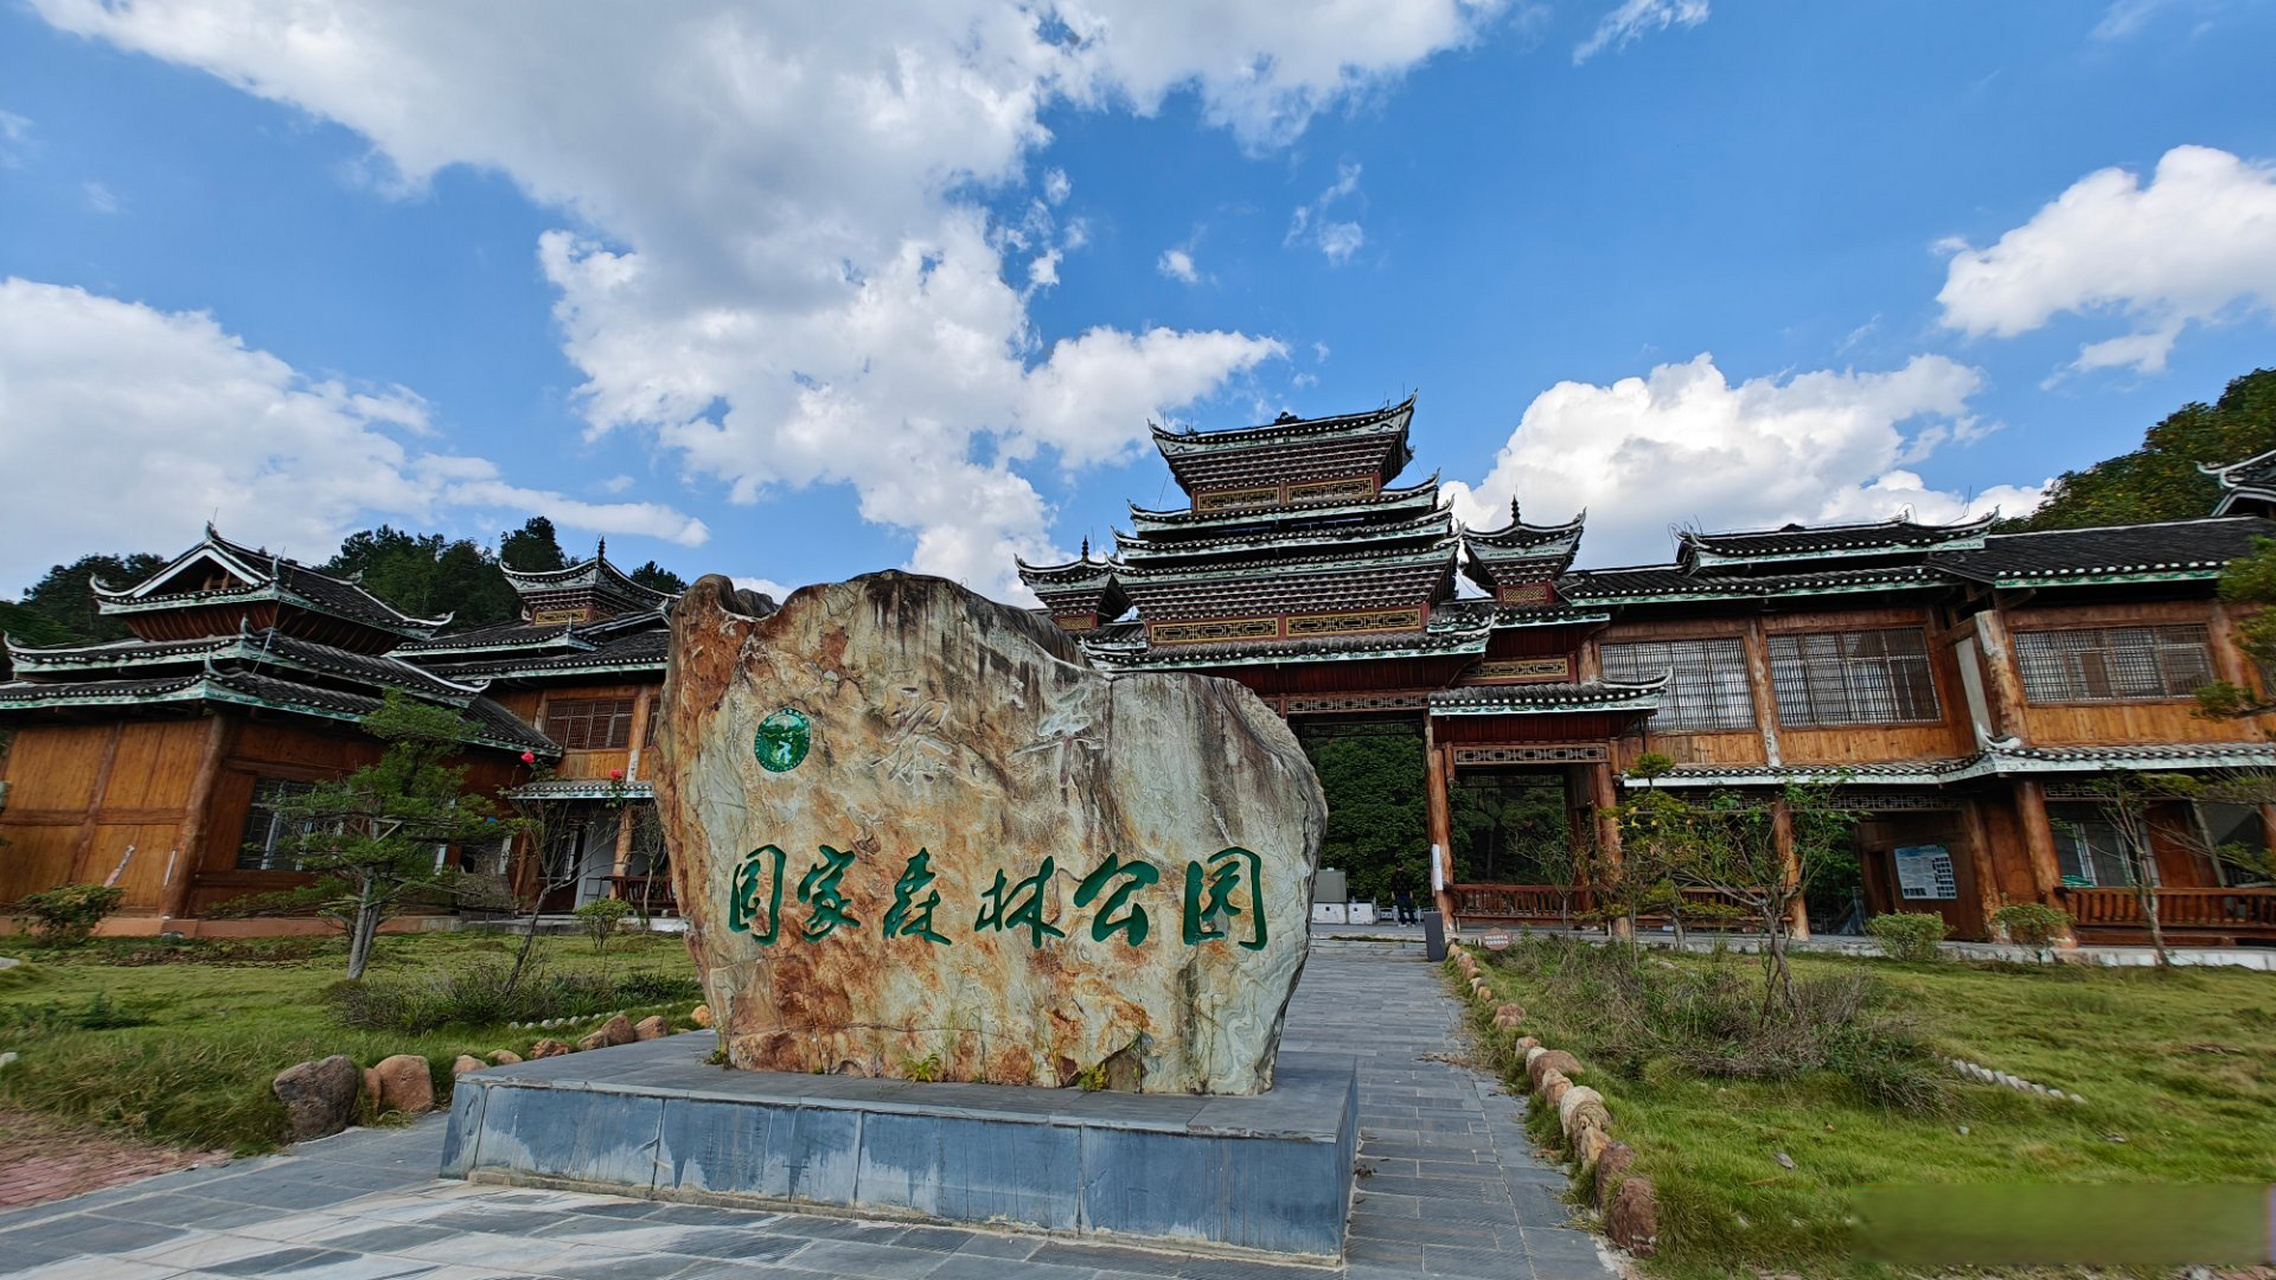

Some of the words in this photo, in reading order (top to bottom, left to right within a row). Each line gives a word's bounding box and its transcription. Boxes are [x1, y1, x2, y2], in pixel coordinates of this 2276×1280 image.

[728, 844, 1268, 952] 国家森林公园
